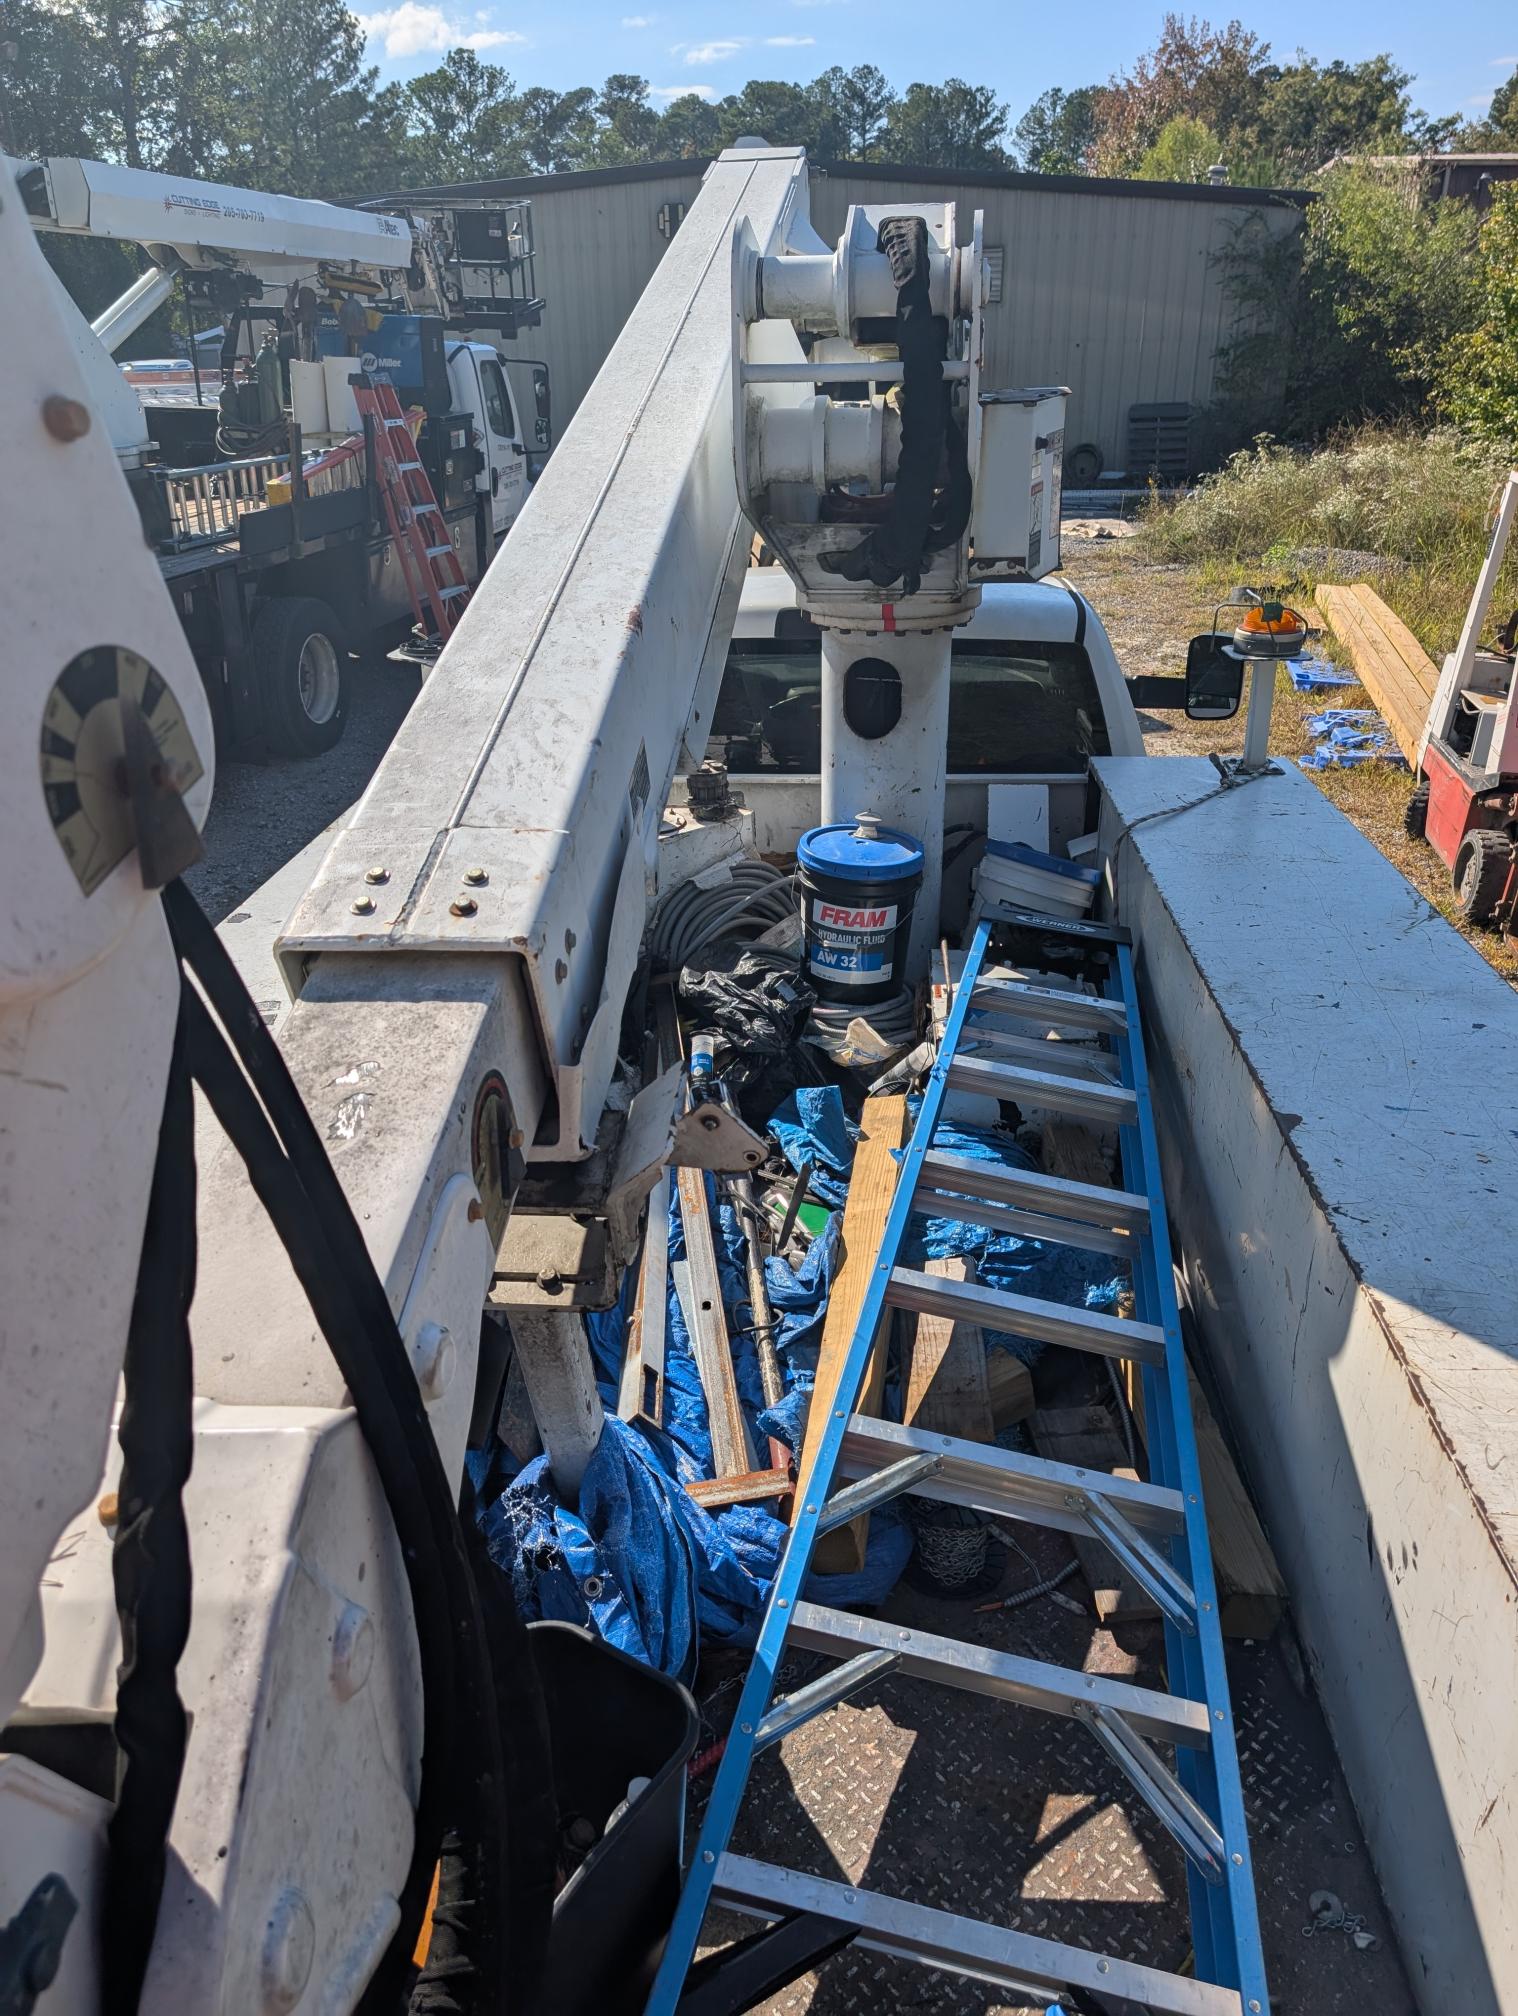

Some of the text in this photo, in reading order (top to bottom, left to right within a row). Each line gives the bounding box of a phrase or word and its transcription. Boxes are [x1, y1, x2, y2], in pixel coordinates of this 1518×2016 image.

[171, 194, 220, 210] CUTTING EDGE
[321, 317, 338, 326] Bob
[378, 358, 402, 368] Miller
[820, 905, 888, 928] FRAM
[1032, 917, 1081, 931] WERNER
[818, 929, 887, 945] HYDRAULIC FLUID
[817, 950, 857, 968] AW 32
